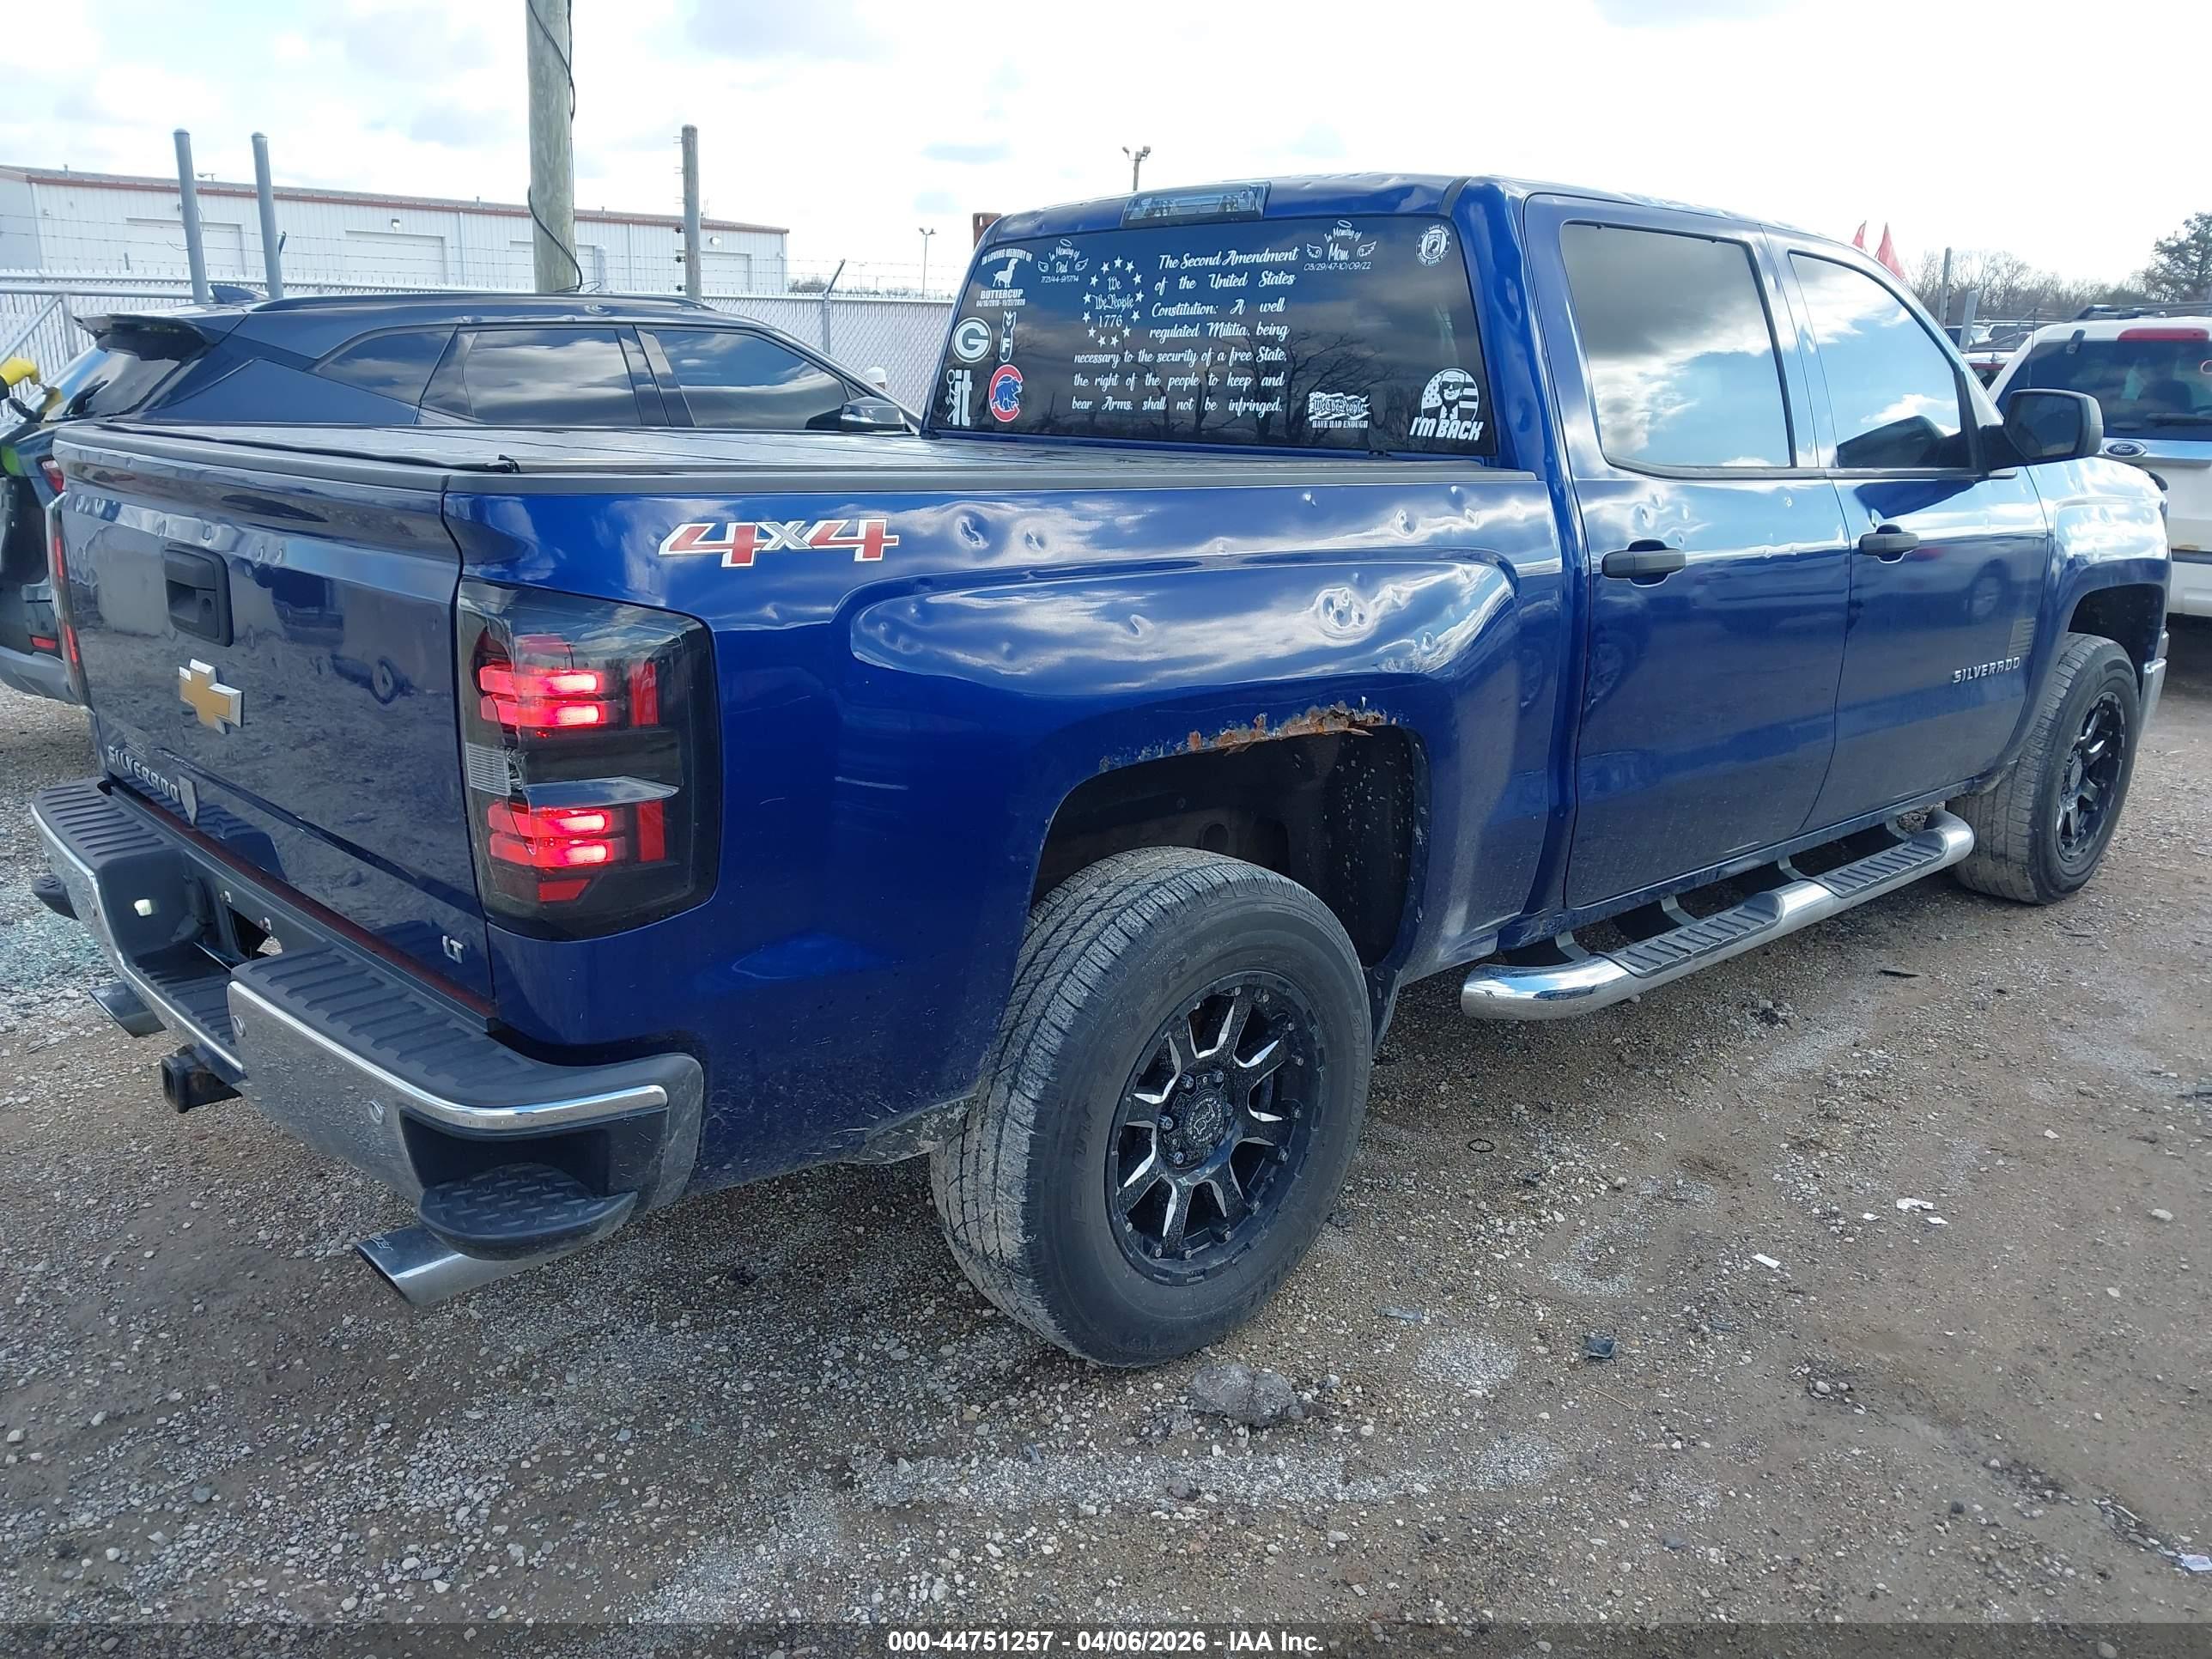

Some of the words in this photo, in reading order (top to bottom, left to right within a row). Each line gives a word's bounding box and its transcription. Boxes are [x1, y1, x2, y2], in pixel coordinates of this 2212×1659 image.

[1333, 227, 1354, 240] Memory
[1006, 248, 1026, 259] MEMORY
[1159, 254, 1179, 270] The
[1180, 251, 1222, 269] Second
[1222, 246, 1300, 265] Amendment
[1328, 243, 1350, 261] Mom
[1056, 260, 1069, 273] Dad
[1107, 276, 1122, 292] We
[1154, 276, 1169, 296] of
[1178, 276, 1196, 289] the
[1208, 272, 1248, 289] United
[1258, 270, 1297, 287] States
[980, 289, 1024, 300] BUTTERCUP
[1152, 301, 1219, 318] Constitution:
[1230, 299, 1245, 315] A
[1259, 297, 1286, 313] well
[1099, 314, 1123, 327] 1776
[955, 321, 989, 358] G
[1149, 323, 1200, 343] regulated
[1256, 321, 1291, 342] being
[1073, 353, 1121, 368] necessary
[1123, 349, 1134, 362] to
[1138, 349, 1155, 362] the
[1157, 348, 1199, 368] security
[1201, 347, 1214, 367] of
[1217, 352, 1227, 362] a
[1229, 346, 1254, 368] free
[1073, 373, 1090, 386] the
[1094, 373, 1120, 392] right
[1125, 372, 1138, 392] of
[1145, 373, 1161, 386] the
[1167, 372, 1201, 392] people
[1207, 373, 1219, 386] to
[1226, 371, 1254, 392] keep
[1261, 371, 1285, 386] and
[1072, 396, 1093, 410] bear
[1142, 395, 1169, 410] shall
[1176, 398, 1195, 410] not
[1204, 396, 1218, 410] be
[1228, 396, 1283, 418] infringed.
[1312, 420, 1328, 428] HAVE
[1329, 420, 1342, 428] HAD
[1343, 420, 1369, 428] ENOUGH
[1409, 416, 1437, 437] I'M
[1435, 418, 1484, 441] BACK
[1953, 656, 2021, 684] SILVERADO
[107, 744, 179, 804] SILVERADO
[442, 935, 464, 963] LT
